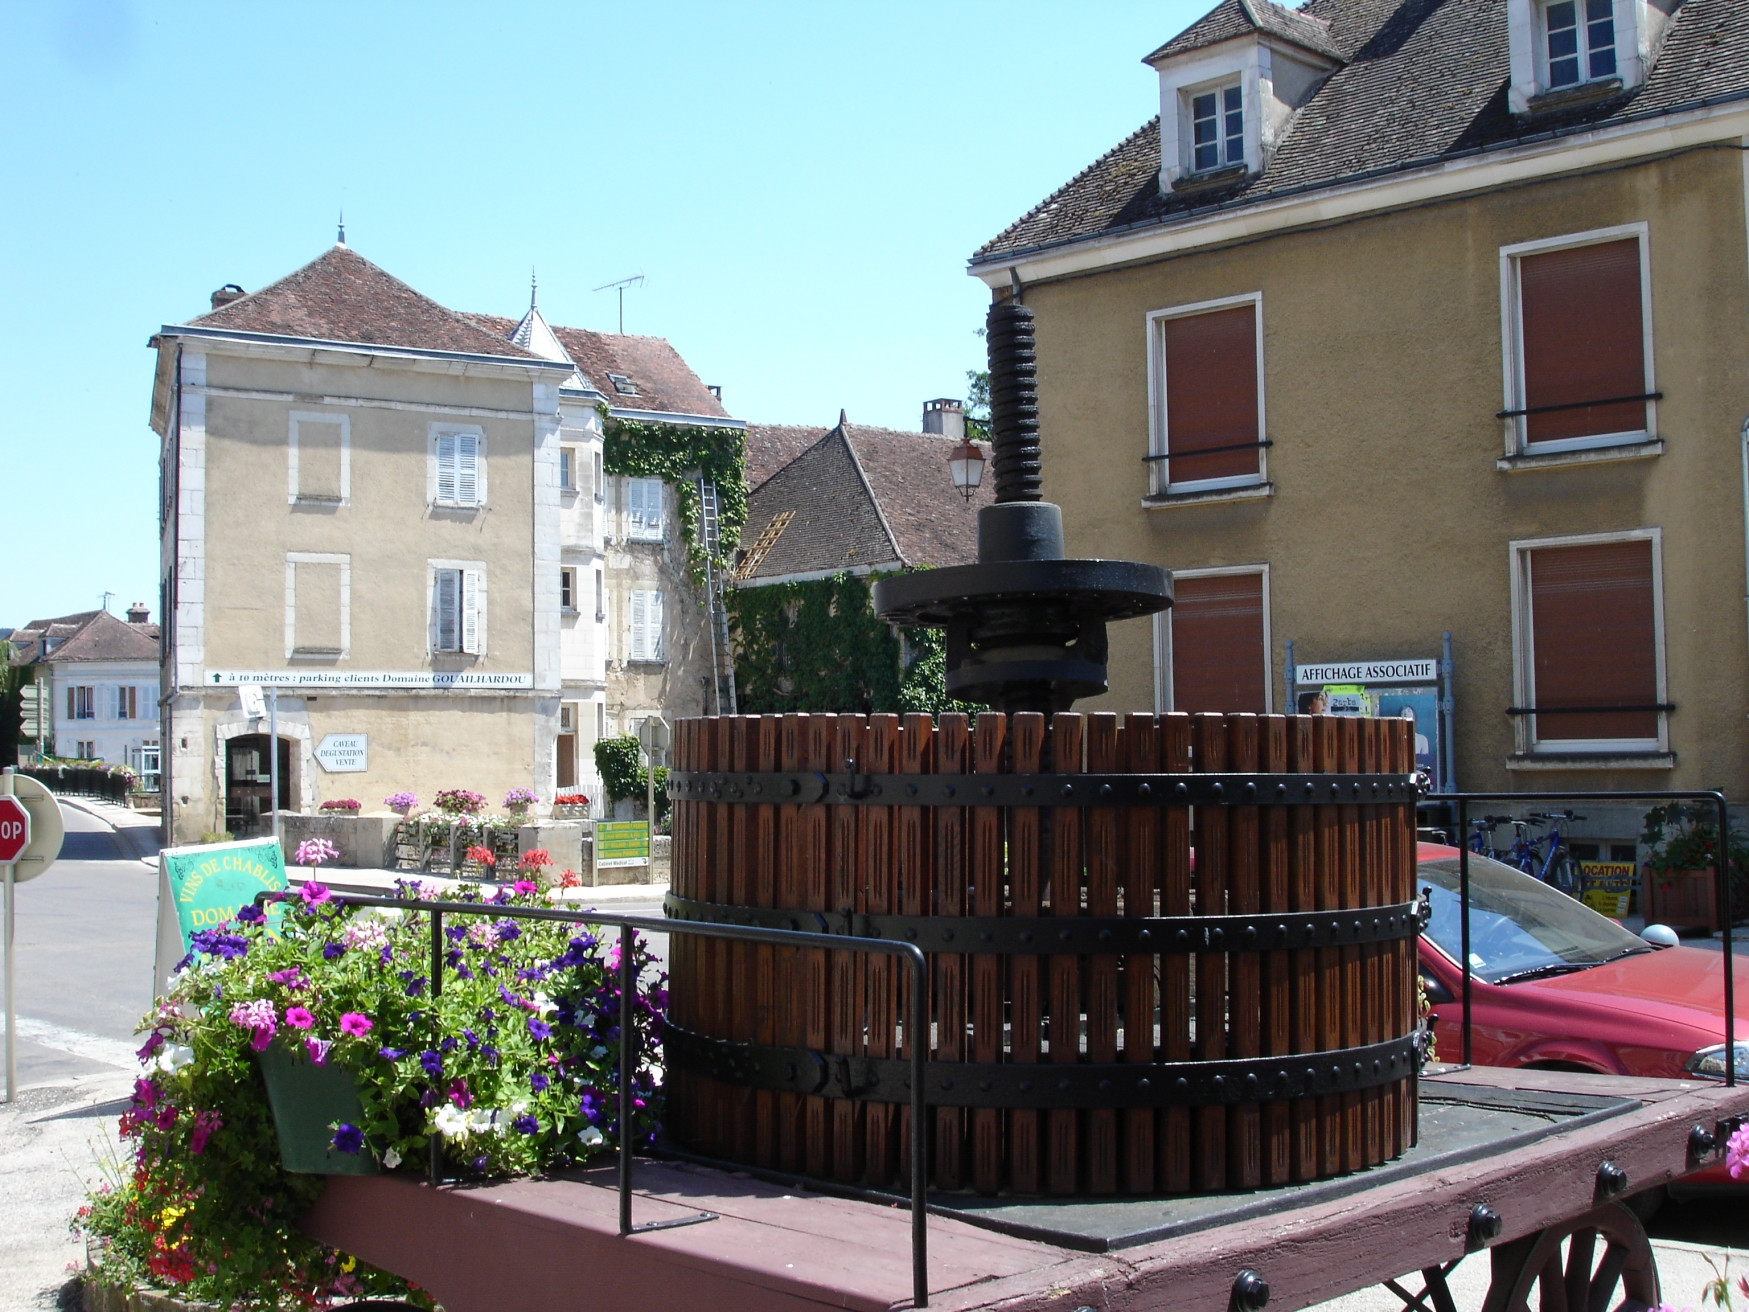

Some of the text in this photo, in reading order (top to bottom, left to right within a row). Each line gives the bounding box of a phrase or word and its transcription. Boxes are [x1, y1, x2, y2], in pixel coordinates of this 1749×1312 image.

[252, 672, 290, 682] mètres
[299, 673, 341, 684] parking
[344, 672, 380, 683] clients
[382, 674, 431, 683] Domaine
[1302, 663, 1431, 681] AFFICHAGE ASSOCIATIF
[333, 740, 358, 748] CAVEAU
[335, 758, 357, 766] VENTE
[0, 821, 22, 840] OP
[1583, 864, 1630, 877] OCATION
[179, 856, 282, 904] VINS DE CHABLIS
